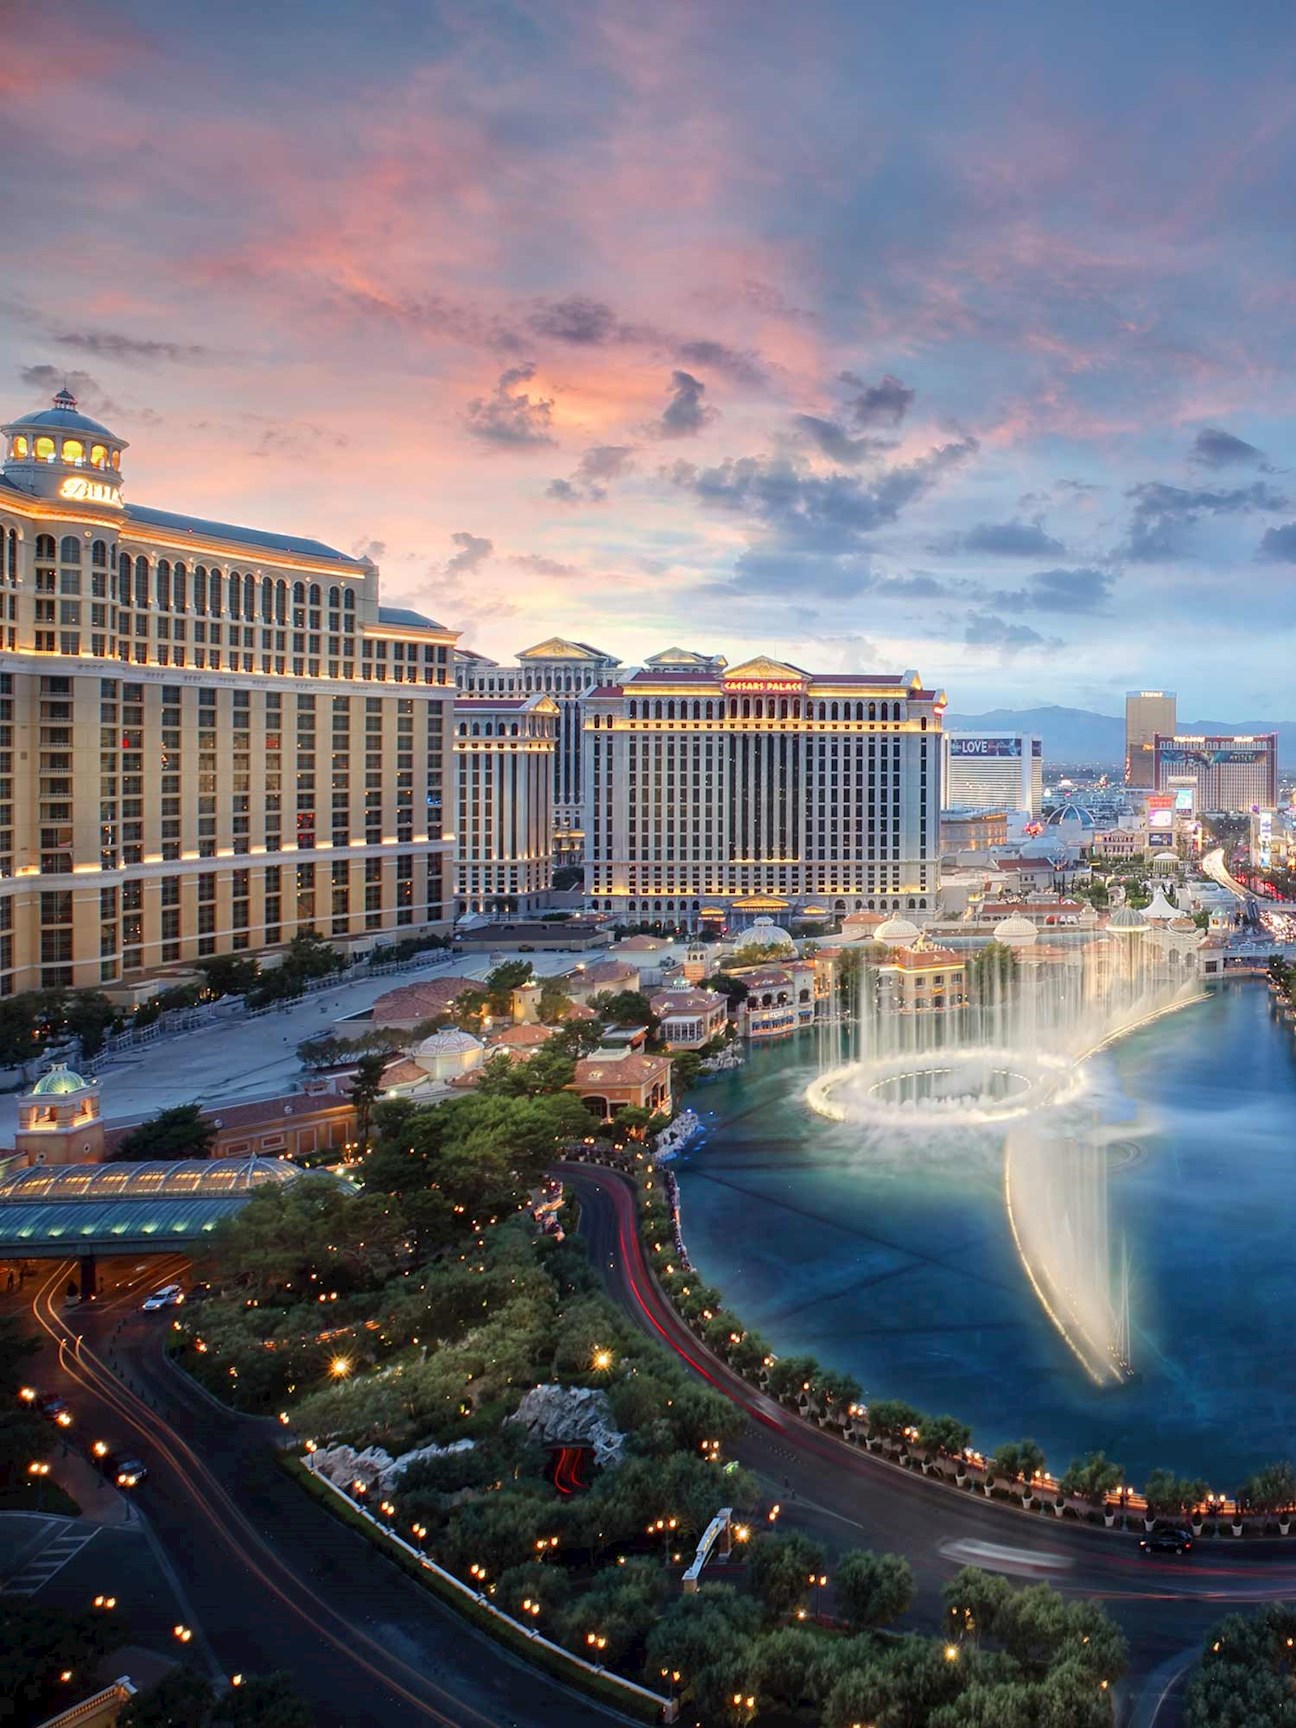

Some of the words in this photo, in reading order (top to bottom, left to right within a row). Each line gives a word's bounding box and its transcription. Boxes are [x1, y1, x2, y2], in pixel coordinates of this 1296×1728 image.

[723, 682, 764, 691] CAESARS
[766, 682, 802, 691] PALACE
[962, 741, 988, 753] LOVE
